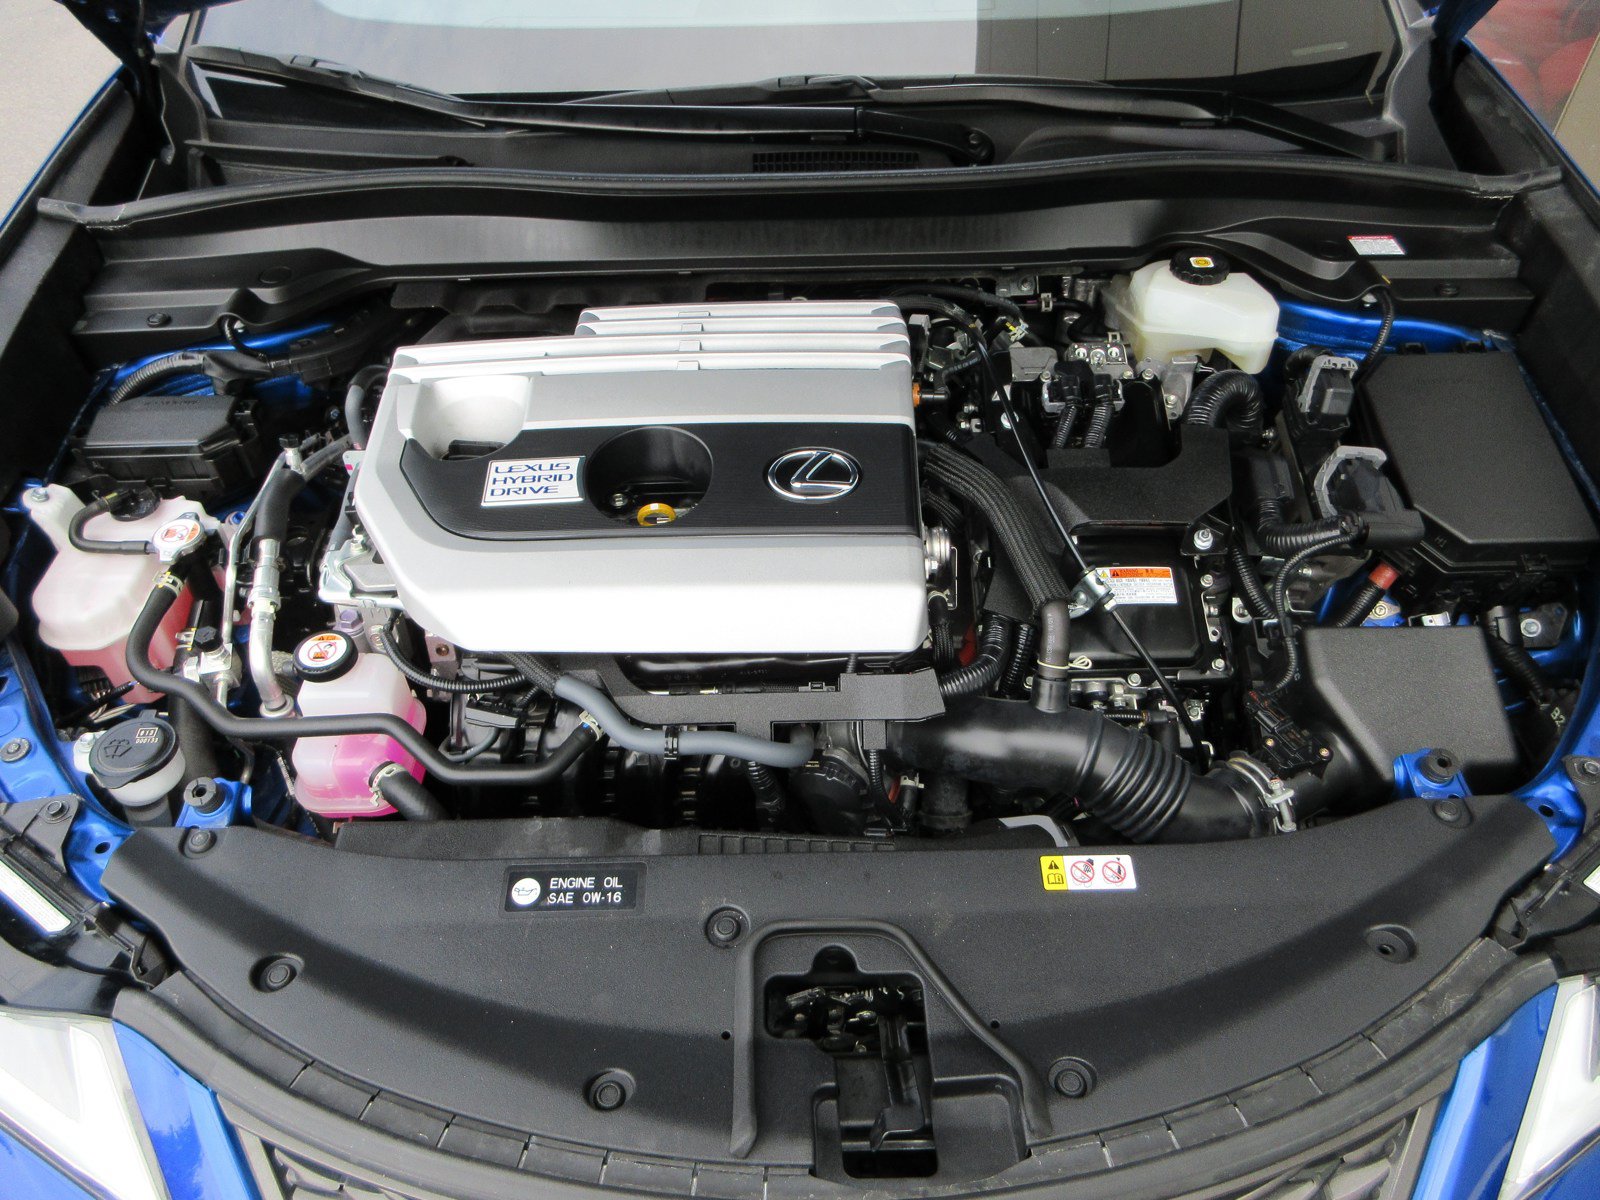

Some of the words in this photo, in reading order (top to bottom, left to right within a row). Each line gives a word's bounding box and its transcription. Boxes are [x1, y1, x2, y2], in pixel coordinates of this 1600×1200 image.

[494, 462, 571, 474] LEXUS
[492, 473, 574, 485] HYBRID
[490, 485, 559, 496] DRIVE
[549, 876, 596, 889] ENGINE
[603, 876, 623, 888] OIL
[548, 891, 575, 904] SAE
[582, 891, 622, 904] 0W-16
